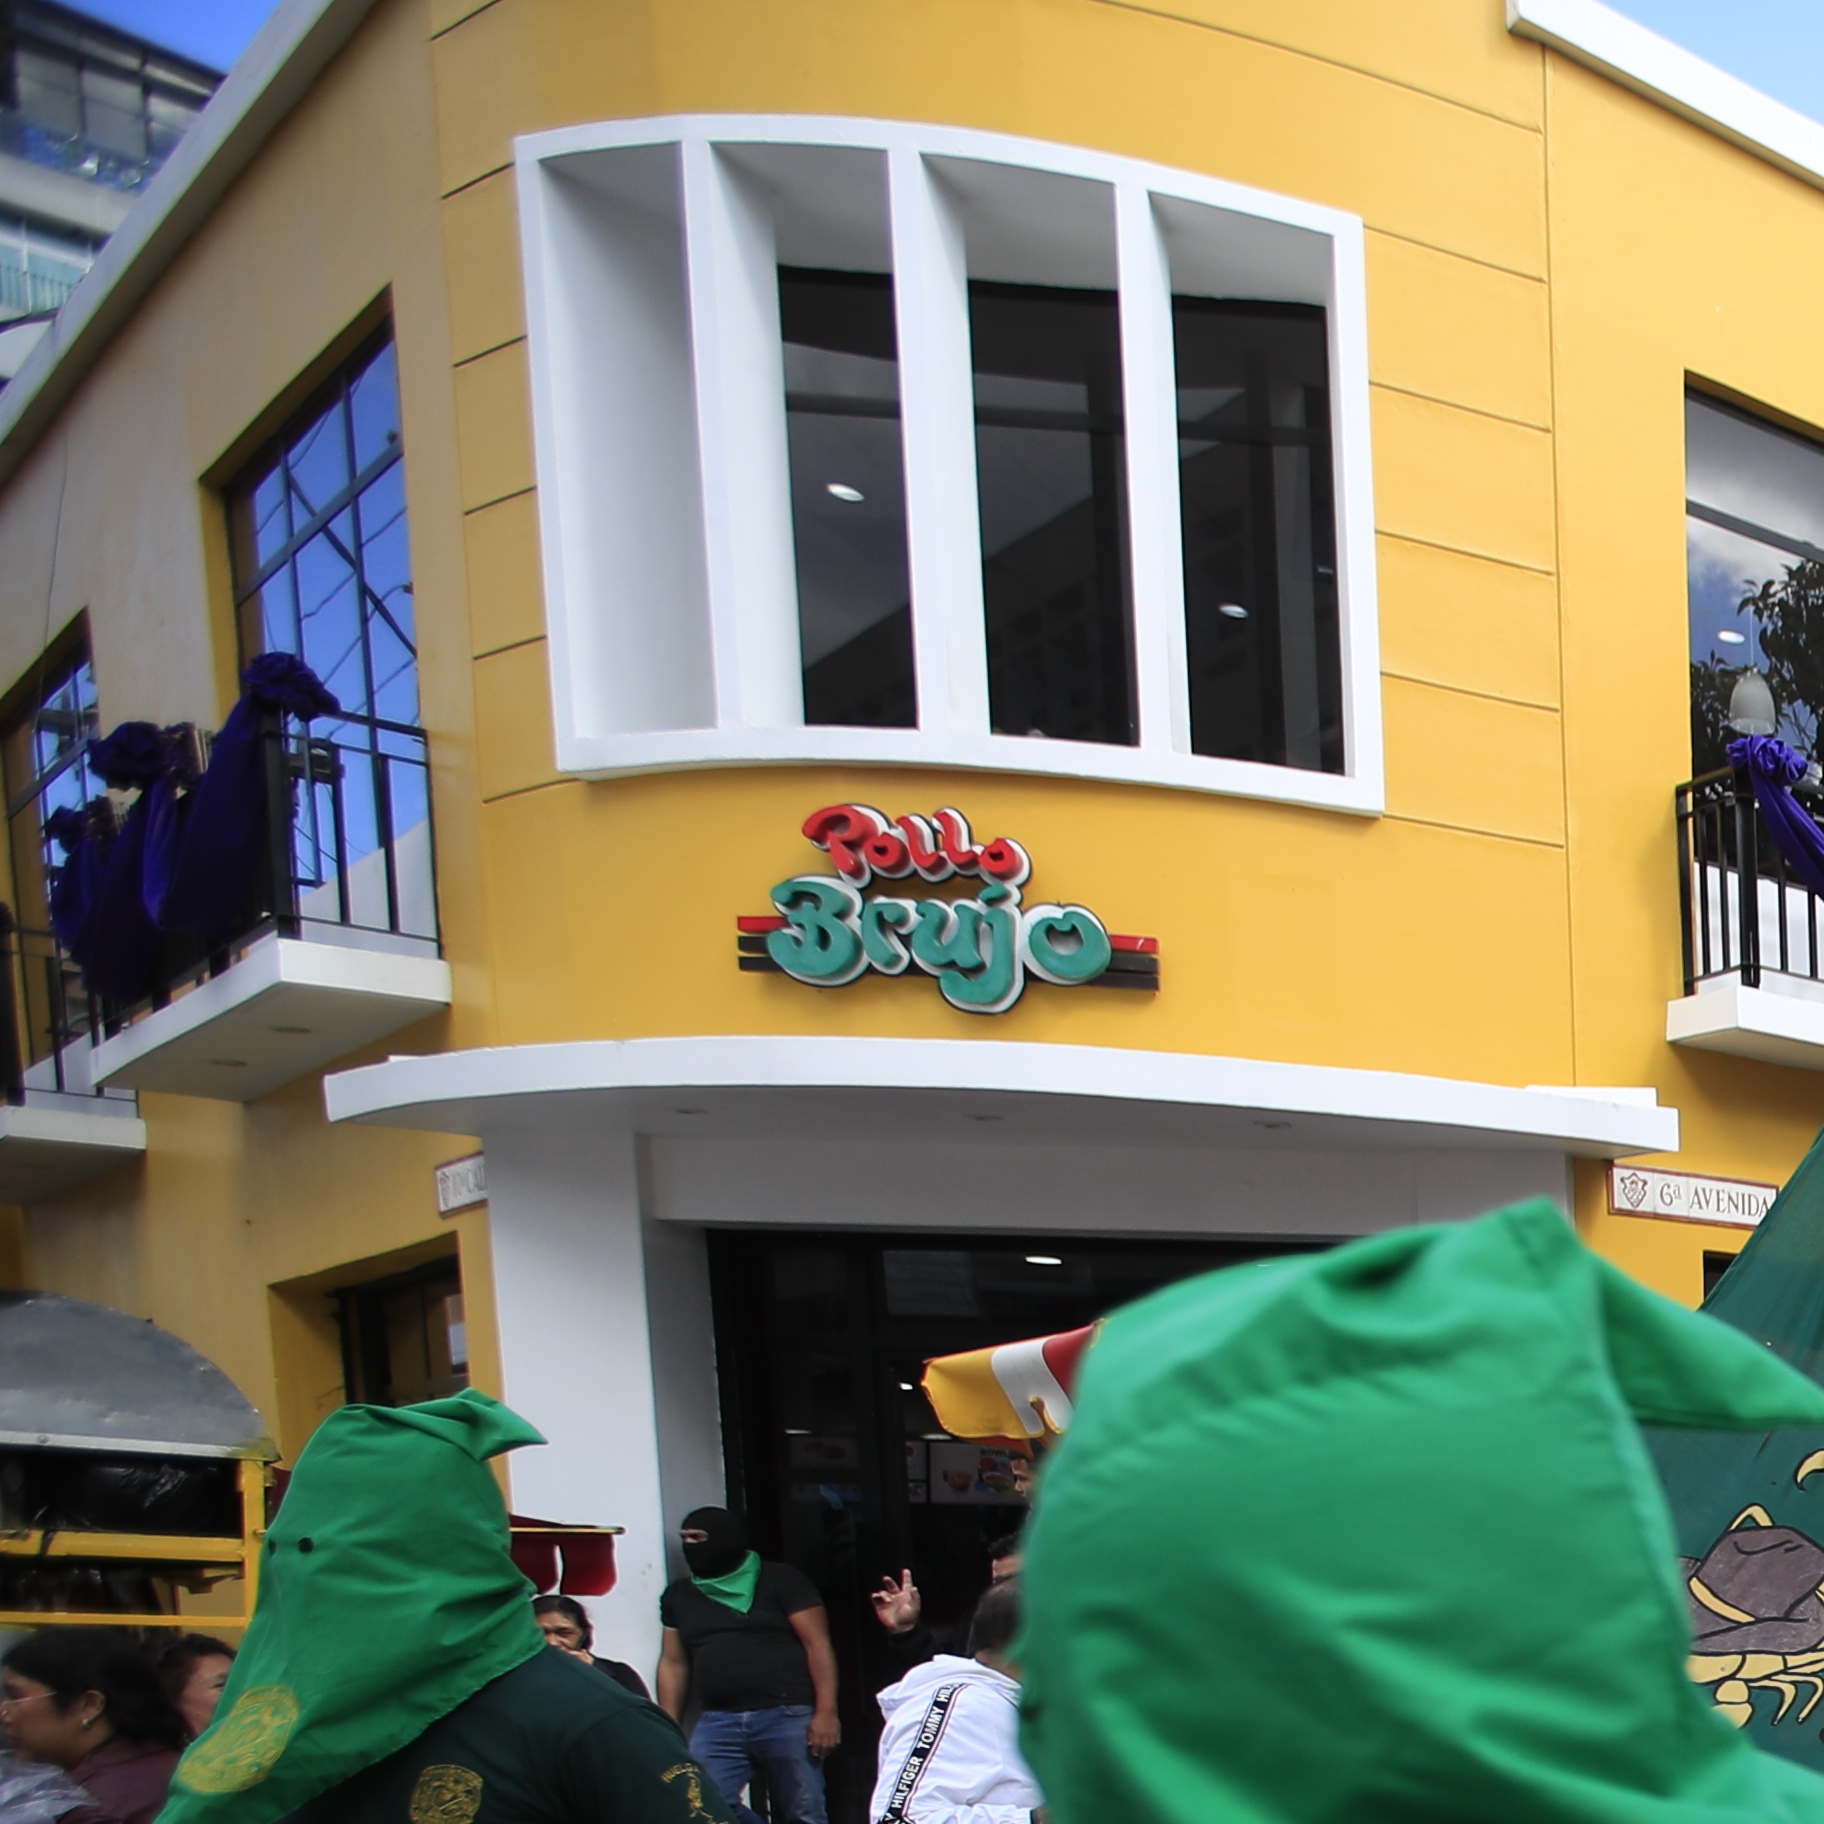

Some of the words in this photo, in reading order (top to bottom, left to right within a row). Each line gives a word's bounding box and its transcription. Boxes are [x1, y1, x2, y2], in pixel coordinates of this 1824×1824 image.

[802, 803, 1026, 882] Pollo
[766, 877, 1112, 1010] Brujo
[1690, 1186, 1770, 1218] AVENIDA
[917, 1706, 945, 1750] TOMMY
[891, 1756, 924, 1809] HILFIGER
